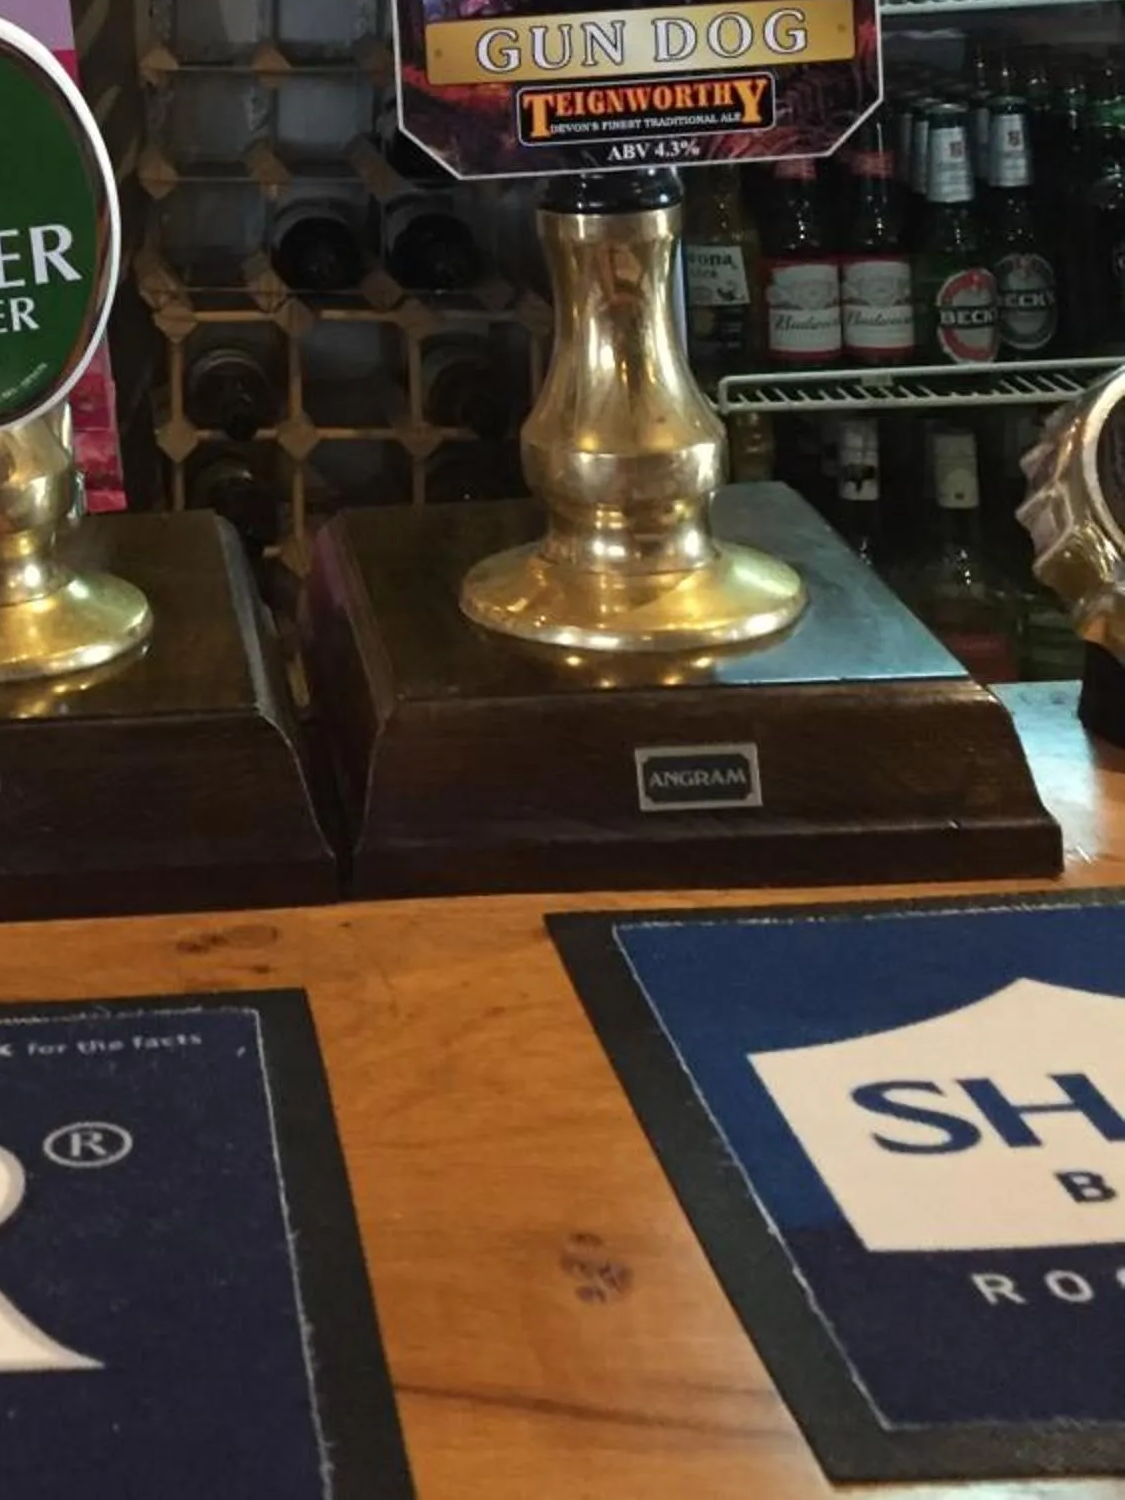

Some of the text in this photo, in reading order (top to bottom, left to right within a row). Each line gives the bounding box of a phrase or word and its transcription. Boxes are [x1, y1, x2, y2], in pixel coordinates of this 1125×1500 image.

[475, 7, 811, 75] GUN DOG
[521, 77, 769, 140] TEIGNWORTHY
[607, 139, 701, 162] ABV 4.3%
[647, 764, 749, 791] ANGRAM
[27, 1042, 67, 1058] for
[75, 1039, 125, 1056] the
[131, 1031, 205, 1050] facts
